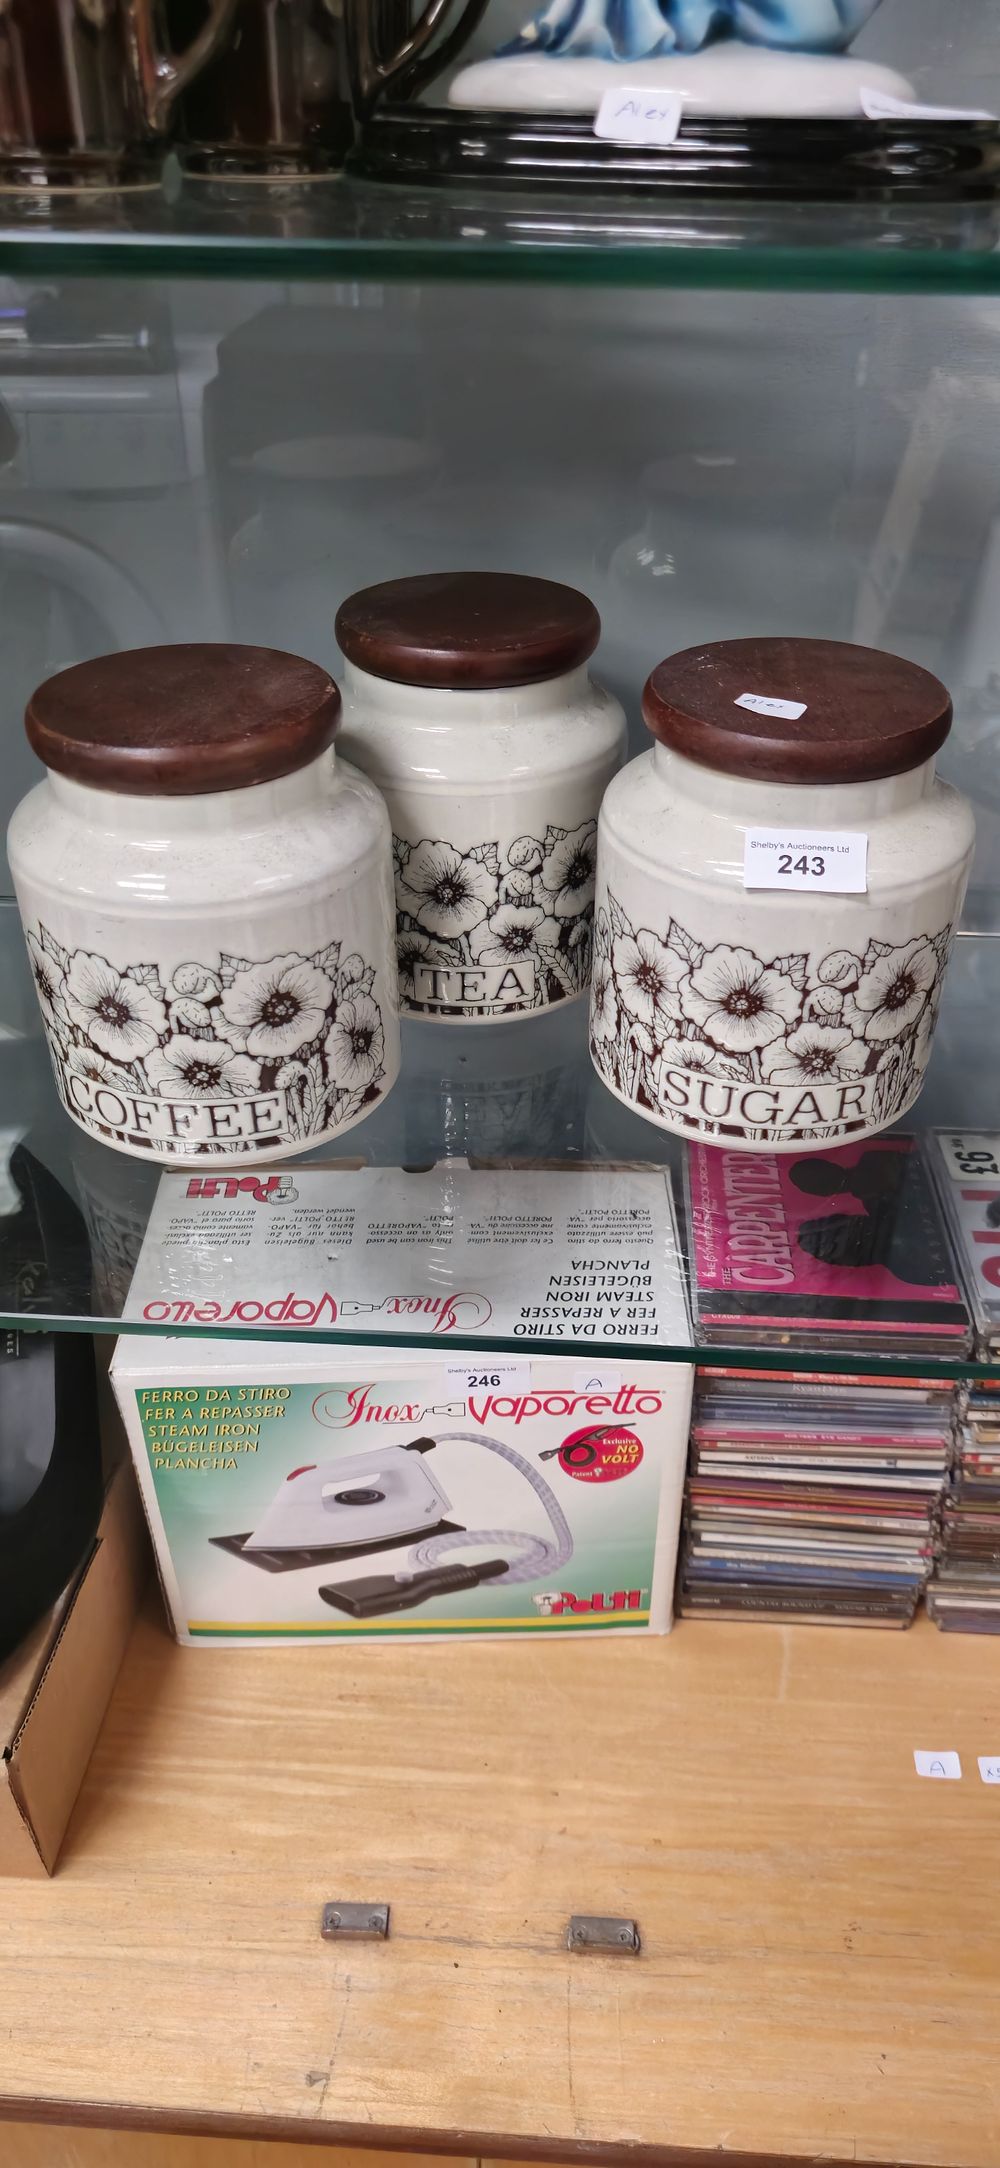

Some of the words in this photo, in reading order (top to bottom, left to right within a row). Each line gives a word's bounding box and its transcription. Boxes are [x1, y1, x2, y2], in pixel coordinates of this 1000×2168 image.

[750, 841, 785, 850] Shelby's
[787, 843, 835, 852] Auctioneers
[777, 855, 825, 876] 243
[420, 968, 529, 1001] TEA
[663, 1070, 868, 1126] SUGAR
[70, 1075, 282, 1138] COFFEE
[571, 1259, 650, 1271] PLANCHA
[549, 1275, 652, 1288] BÜGELEISEN
[546, 1291, 590, 1302] IRON
[596, 1291, 654, 1302] STEAM
[143, 1292, 338, 1326] Vaporetto
[520, 1306, 604, 1318] REPASSER
[609, 1307, 621, 1318] A
[627, 1306, 656, 1318] FER
[513, 1323, 565, 1336] STIRO
[572, 1324, 596, 1336] DA
[603, 1324, 658, 1335] FERRO
[467, 1375, 500, 1387] 246
[586, 1378, 602, 1390] A
[142, 1390, 199, 1403] FERRO
[206, 1388, 231, 1401] DA
[237, 1387, 292, 1400] STIRO
[468, 1384, 662, 1425] Vaporetto
[145, 1407, 176, 1421] FER
[182, 1408, 195, 1420] A
[200, 1405, 286, 1419] REPASSER
[149, 1424, 209, 1437] STEAM
[215, 1423, 261, 1436] IRON
[152, 1440, 259, 1453] BÜGELEISEN
[616, 1445, 639, 1453] NO
[155, 1457, 238, 1469] PLANCHA
[601, 1454, 639, 1463] VOLT
[930, 1761, 945, 1775] A
